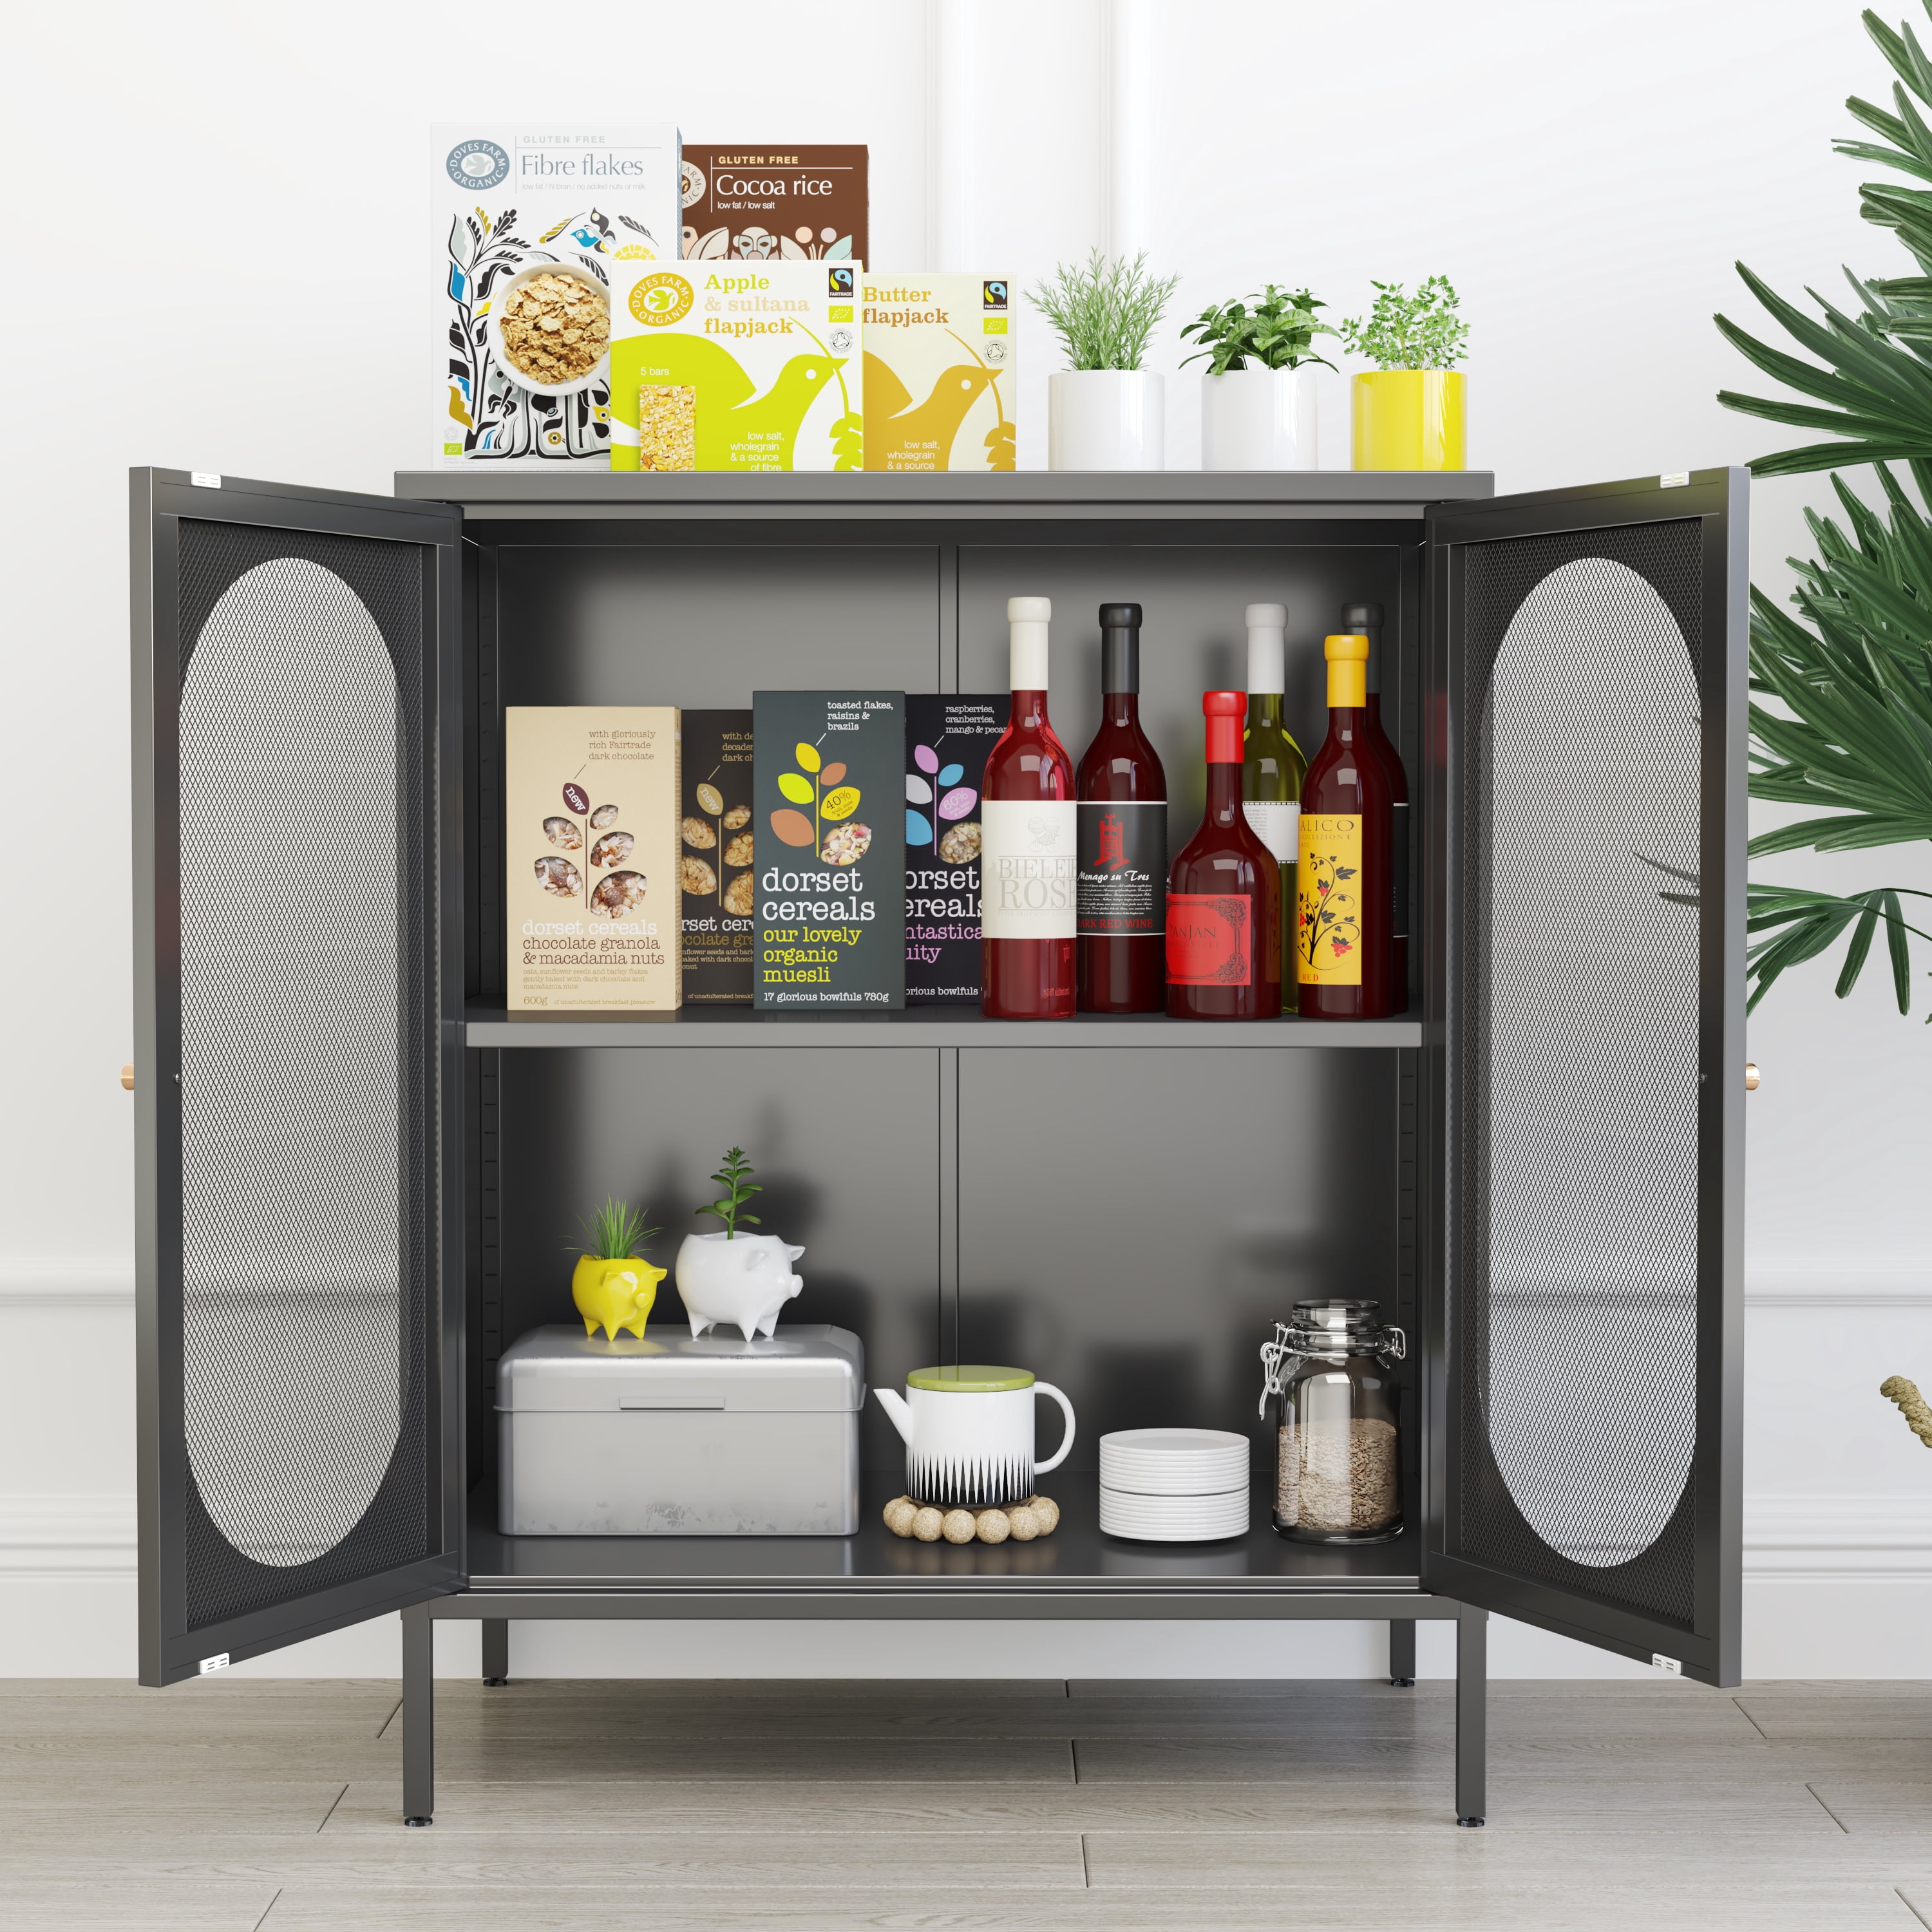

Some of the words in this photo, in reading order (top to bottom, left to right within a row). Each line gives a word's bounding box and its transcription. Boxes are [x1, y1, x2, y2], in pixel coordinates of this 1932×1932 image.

[523, 135, 570, 144] GLUTEN
[576, 135, 605, 144] FREE
[450, 142, 480, 167] DOVES
[482, 143, 506, 167] FARM
[522, 153, 575, 175] Fibre
[582, 153, 643, 175] flakes
[452, 171, 504, 188] ORGANIC
[682, 165, 701, 185] ARM
[716, 175, 786, 196] Cocoa
[793, 175, 833, 196] rice
[717, 201, 730, 209] low
[732, 201, 741, 209] fat
[748, 201, 761, 209] low
[762, 201, 775, 209] salt
[704, 274, 770, 295] Apple
[632, 276, 658, 308] DOVES
[661, 276, 689, 296] FARM
[863, 287, 931, 302] Butter
[704, 296, 721, 312] &
[728, 296, 810, 312] sultana
[640, 301, 689, 325] ORGANIC
[863, 308, 949, 328] flapjack
[704, 318, 793, 338] flapjack
[640, 367, 646, 375] 5
[650, 367, 670, 375] bars
[748, 431, 762, 440] low
[766, 431, 784, 441] salt,
[730, 442, 779, 453] wholegrain
[904, 440, 919, 449] low
[922, 440, 940, 450] salt,
[730, 453, 737, 462] &
[887, 451, 935, 462] wholegrain
[828, 701, 862, 709] toasted
[864, 701, 894, 710] flakes,
[945, 705, 994, 714] raspberries,
[828, 712, 860, 720] raisins
[862, 712, 870, 720] &
[945, 715, 995, 724] cranberries,
[589, 730, 609, 739] with
[612, 730, 656, 740] gloriously
[945, 726, 974, 735] mango
[589, 741, 607, 749] rich
[609, 741, 651, 749] Fairtrade
[589, 752, 610, 760] dark
[612, 752, 654, 760] chocolate
[565, 786, 586, 811] new
[700, 787, 719, 811] new
[827, 790, 851, 809] 40%
[943, 790, 968, 810] 60%
[1299, 820, 1354, 831] ALICO
[762, 867, 863, 892] dorset
[1124, 870, 1150, 882] Tres
[762, 896, 875, 921] cereals
[522, 920, 583, 935] dorset
[589, 920, 658, 935] cereals
[1077, 919, 1097, 928] DARK
[1099, 919, 1122, 928] RED
[1124, 919, 1153, 928] WINE
[763, 930, 798, 942] our
[802, 927, 862, 945] lovely
[523, 937, 596, 949] chocolate
[600, 937, 660, 952] granola
[523, 952, 536, 964] &
[539, 952, 627, 964] macadamia
[630, 953, 665, 964] nuts
[763, 947, 838, 965] organic
[763, 967, 831, 983] muesli
[764, 992, 774, 1001] 17
[777, 992, 818, 1002] glorious
[820, 992, 862, 1001] bowlfuls
[864, 992, 889, 1002] 780g
[938, 987, 978, 995] bowlfuls
[524, 996, 547, 1006] 600g
